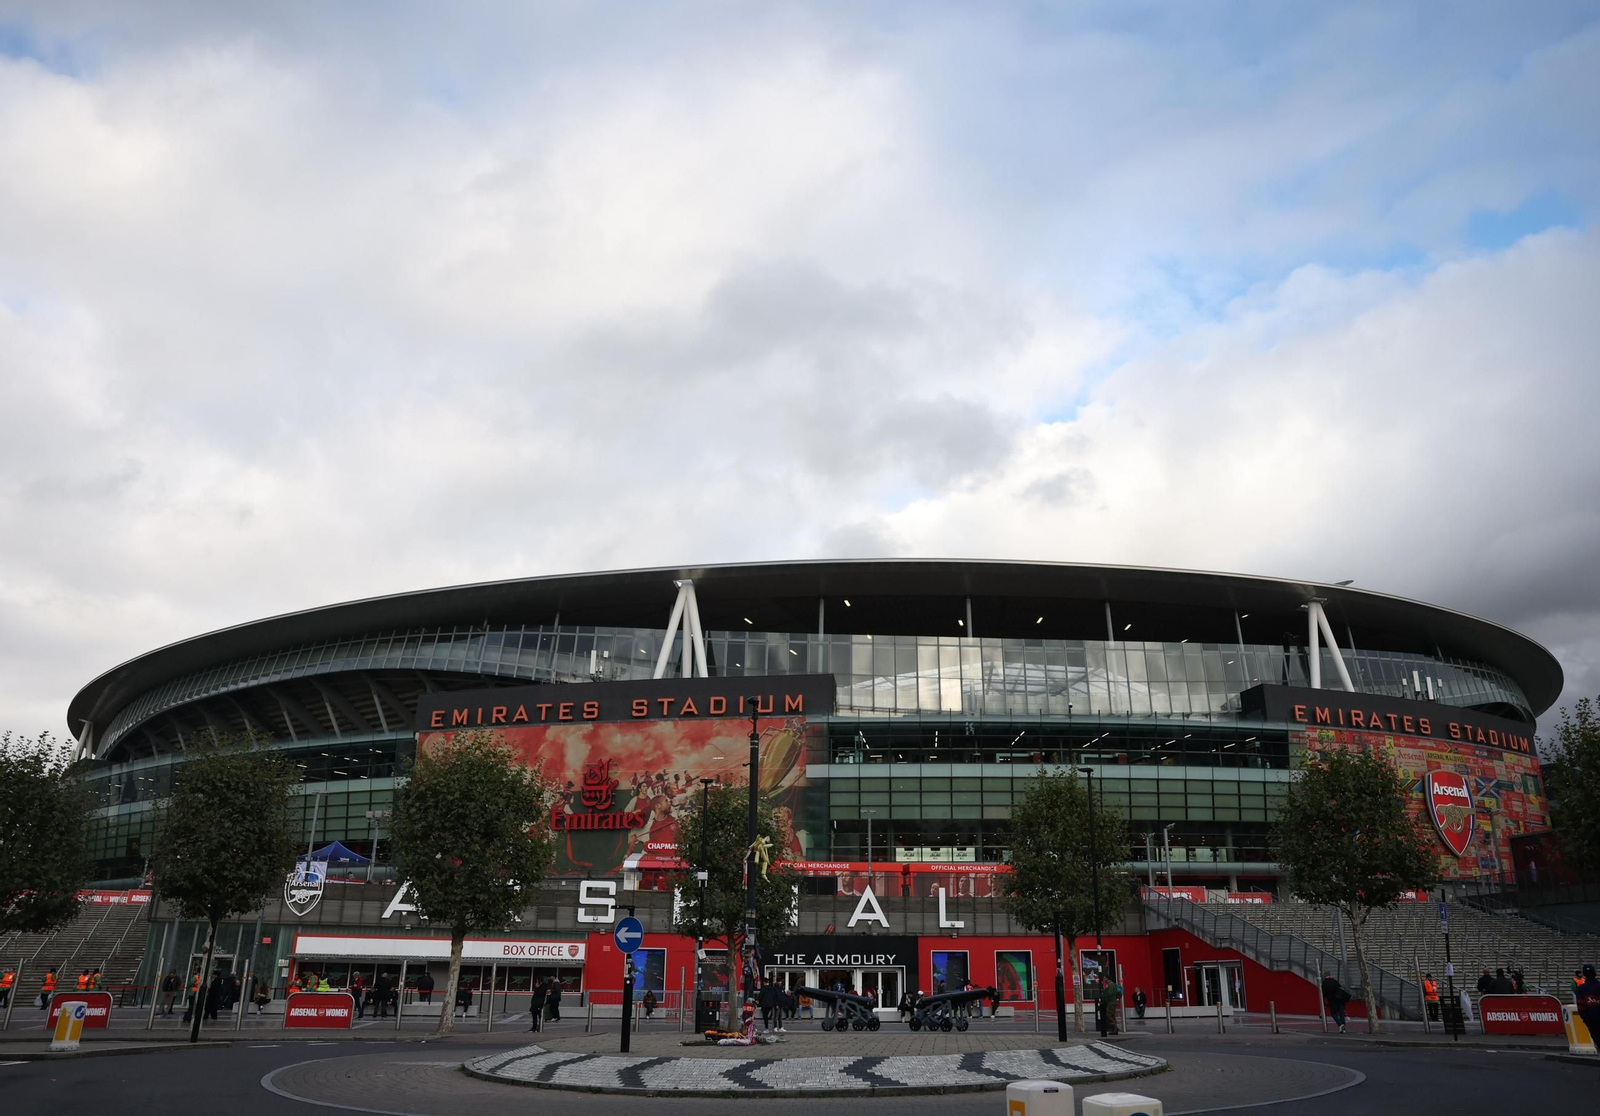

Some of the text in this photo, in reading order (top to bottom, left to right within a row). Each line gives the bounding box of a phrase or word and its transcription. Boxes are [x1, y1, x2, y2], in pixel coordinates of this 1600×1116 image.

[429, 694, 804, 729] EMIRATES STADIUM
[1293, 704, 1530, 753] EMIRATES STADIUM
[1433, 782, 1469, 799] Arsenal
[551, 808, 646, 831] Emirates
[503, 944, 564, 957] BOX OFFICE
[774, 953, 897, 965] THE ARMOURY
[85, 1007, 107, 1017] WOMEN
[290, 1007, 349, 1018] ARSENAL WOMEN
[1486, 1011, 1560, 1022] ARSENAL WOMEN
